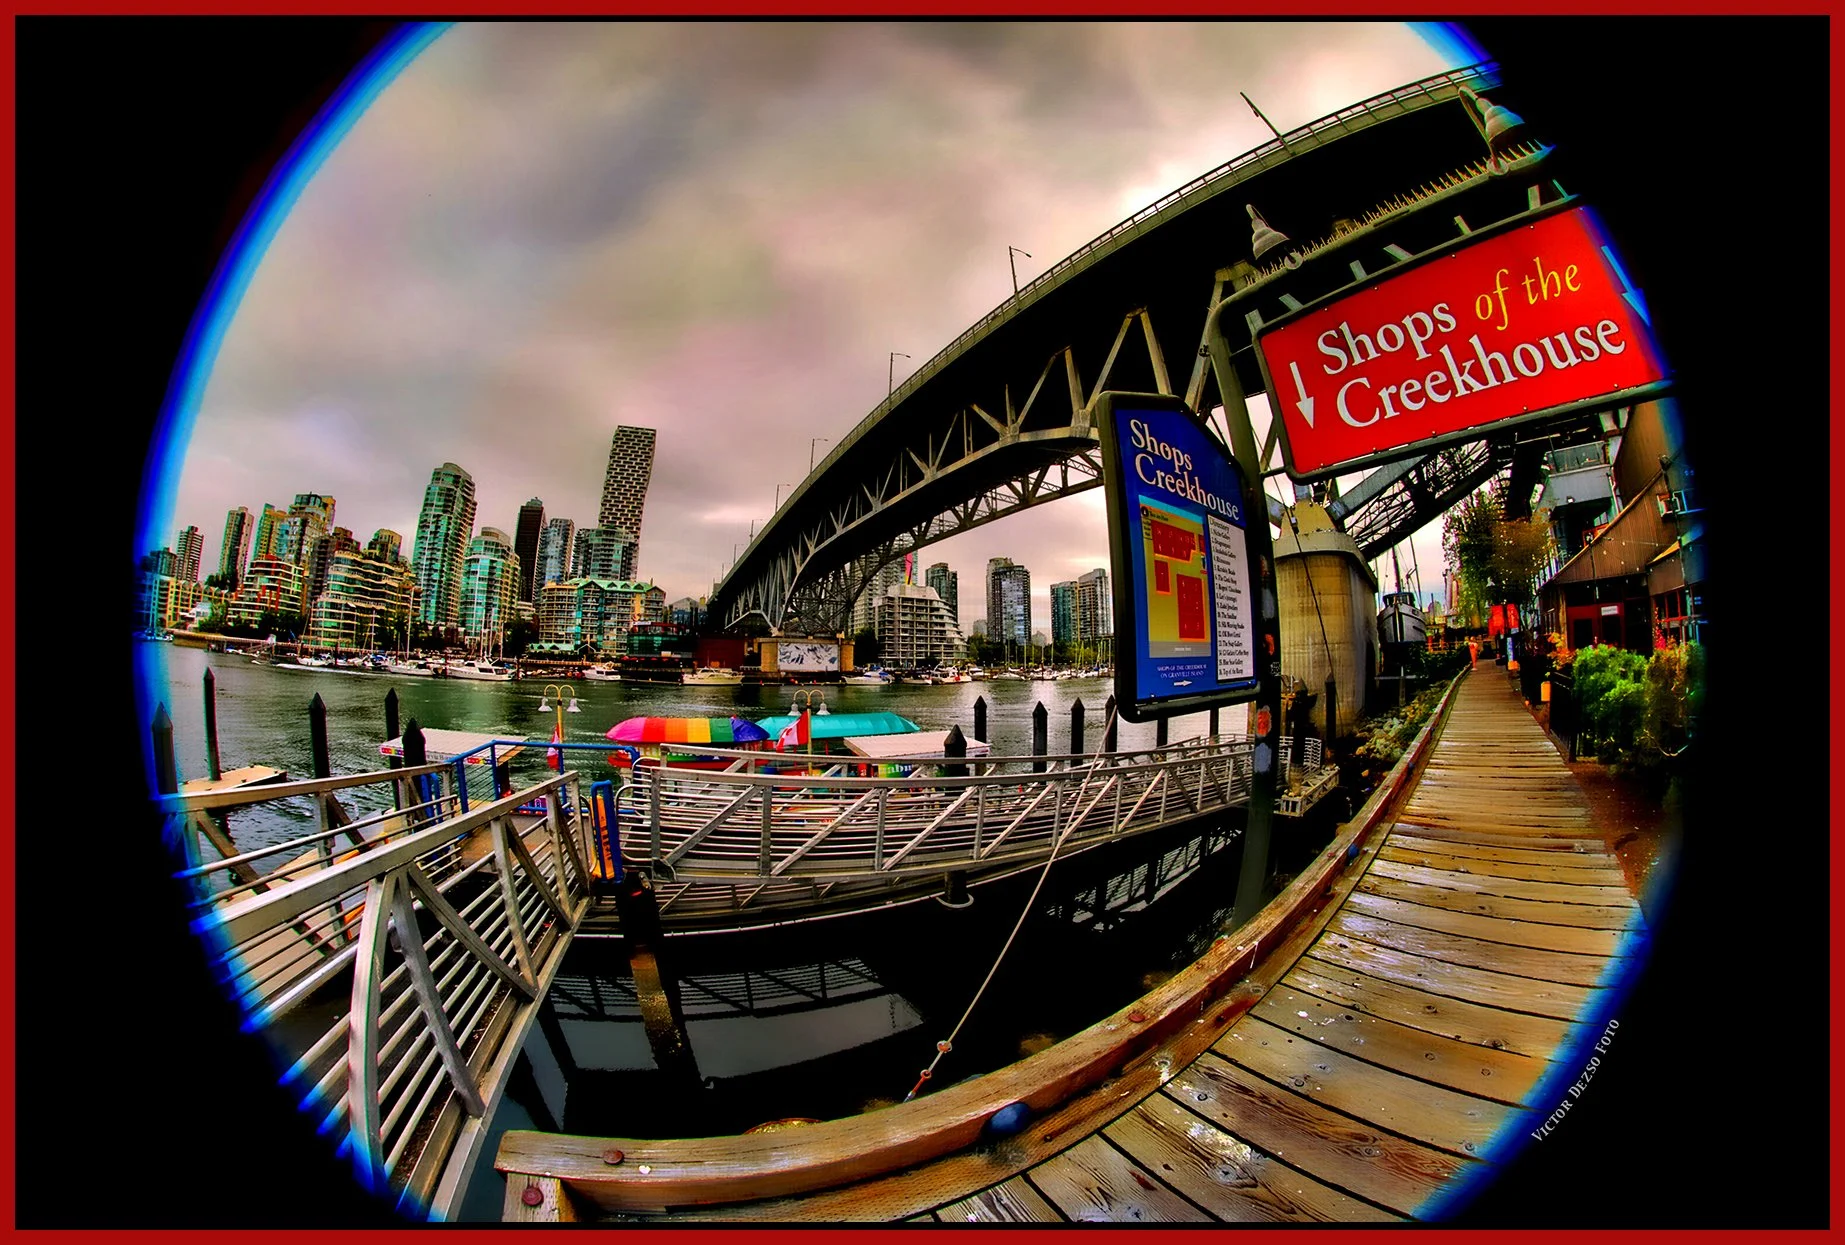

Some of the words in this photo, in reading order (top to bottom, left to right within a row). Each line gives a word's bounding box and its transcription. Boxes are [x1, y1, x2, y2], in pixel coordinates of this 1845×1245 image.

[1316, 302, 1457, 375] Shops
[1474, 269, 1510, 331] of
[1522, 256, 1581, 306] the
[1336, 319, 1626, 428] Creekhouse
[1130, 419, 1193, 474] Shops
[1135, 453, 1240, 520] Creekhouse
